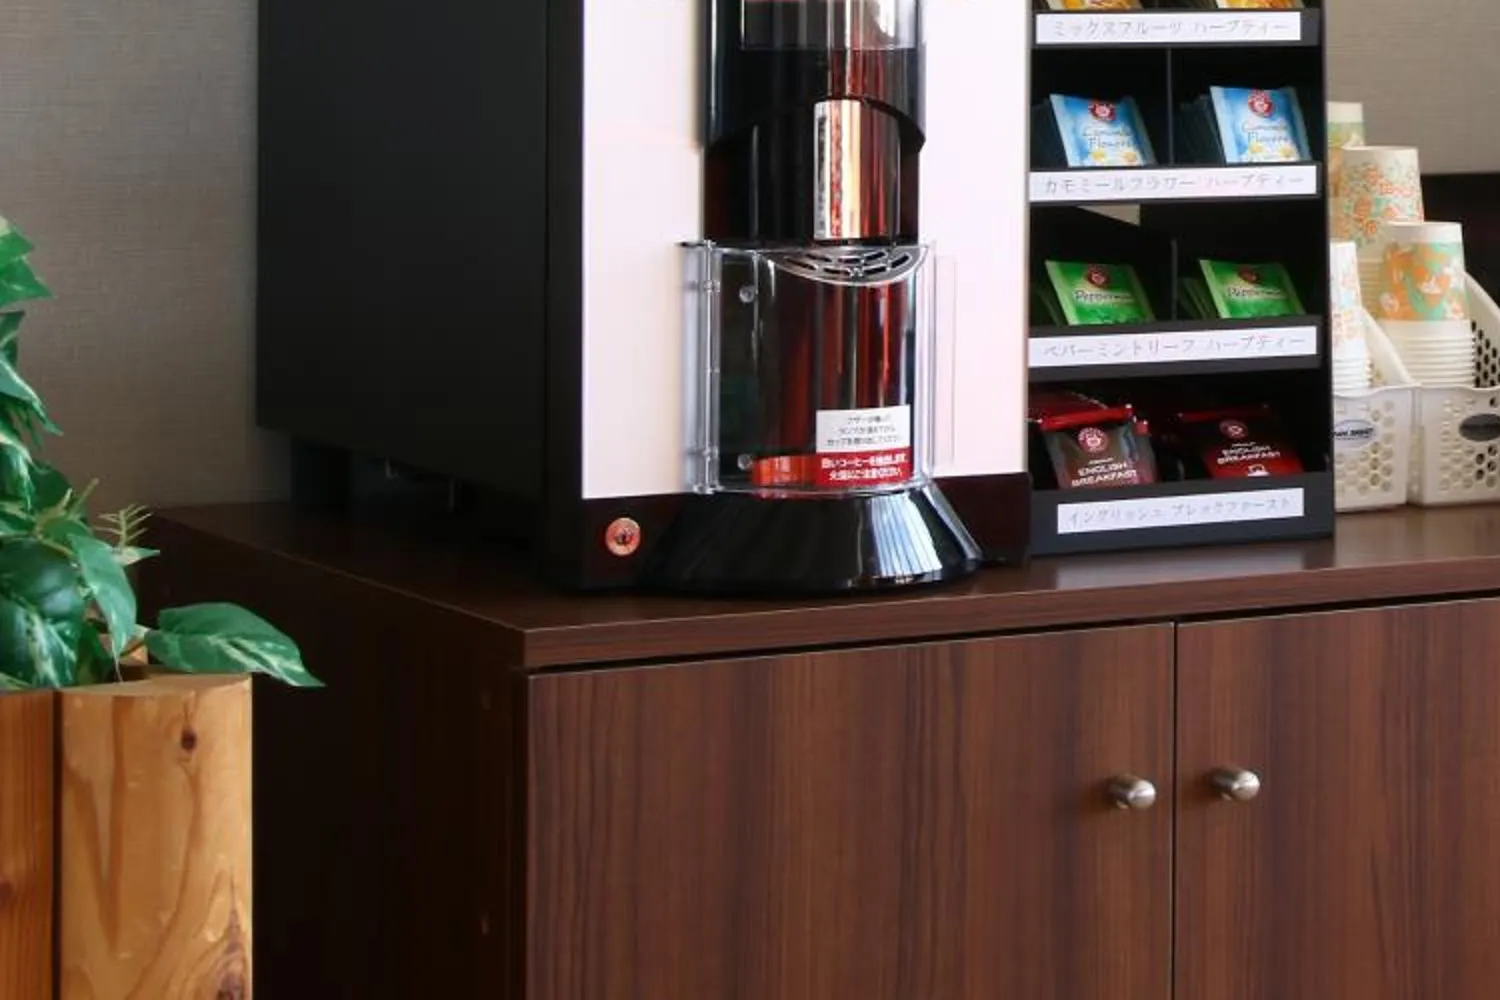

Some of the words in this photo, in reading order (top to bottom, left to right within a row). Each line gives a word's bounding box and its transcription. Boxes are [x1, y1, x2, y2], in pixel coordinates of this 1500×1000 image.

[1054, 19, 1183, 38] ミックスフルーツ
